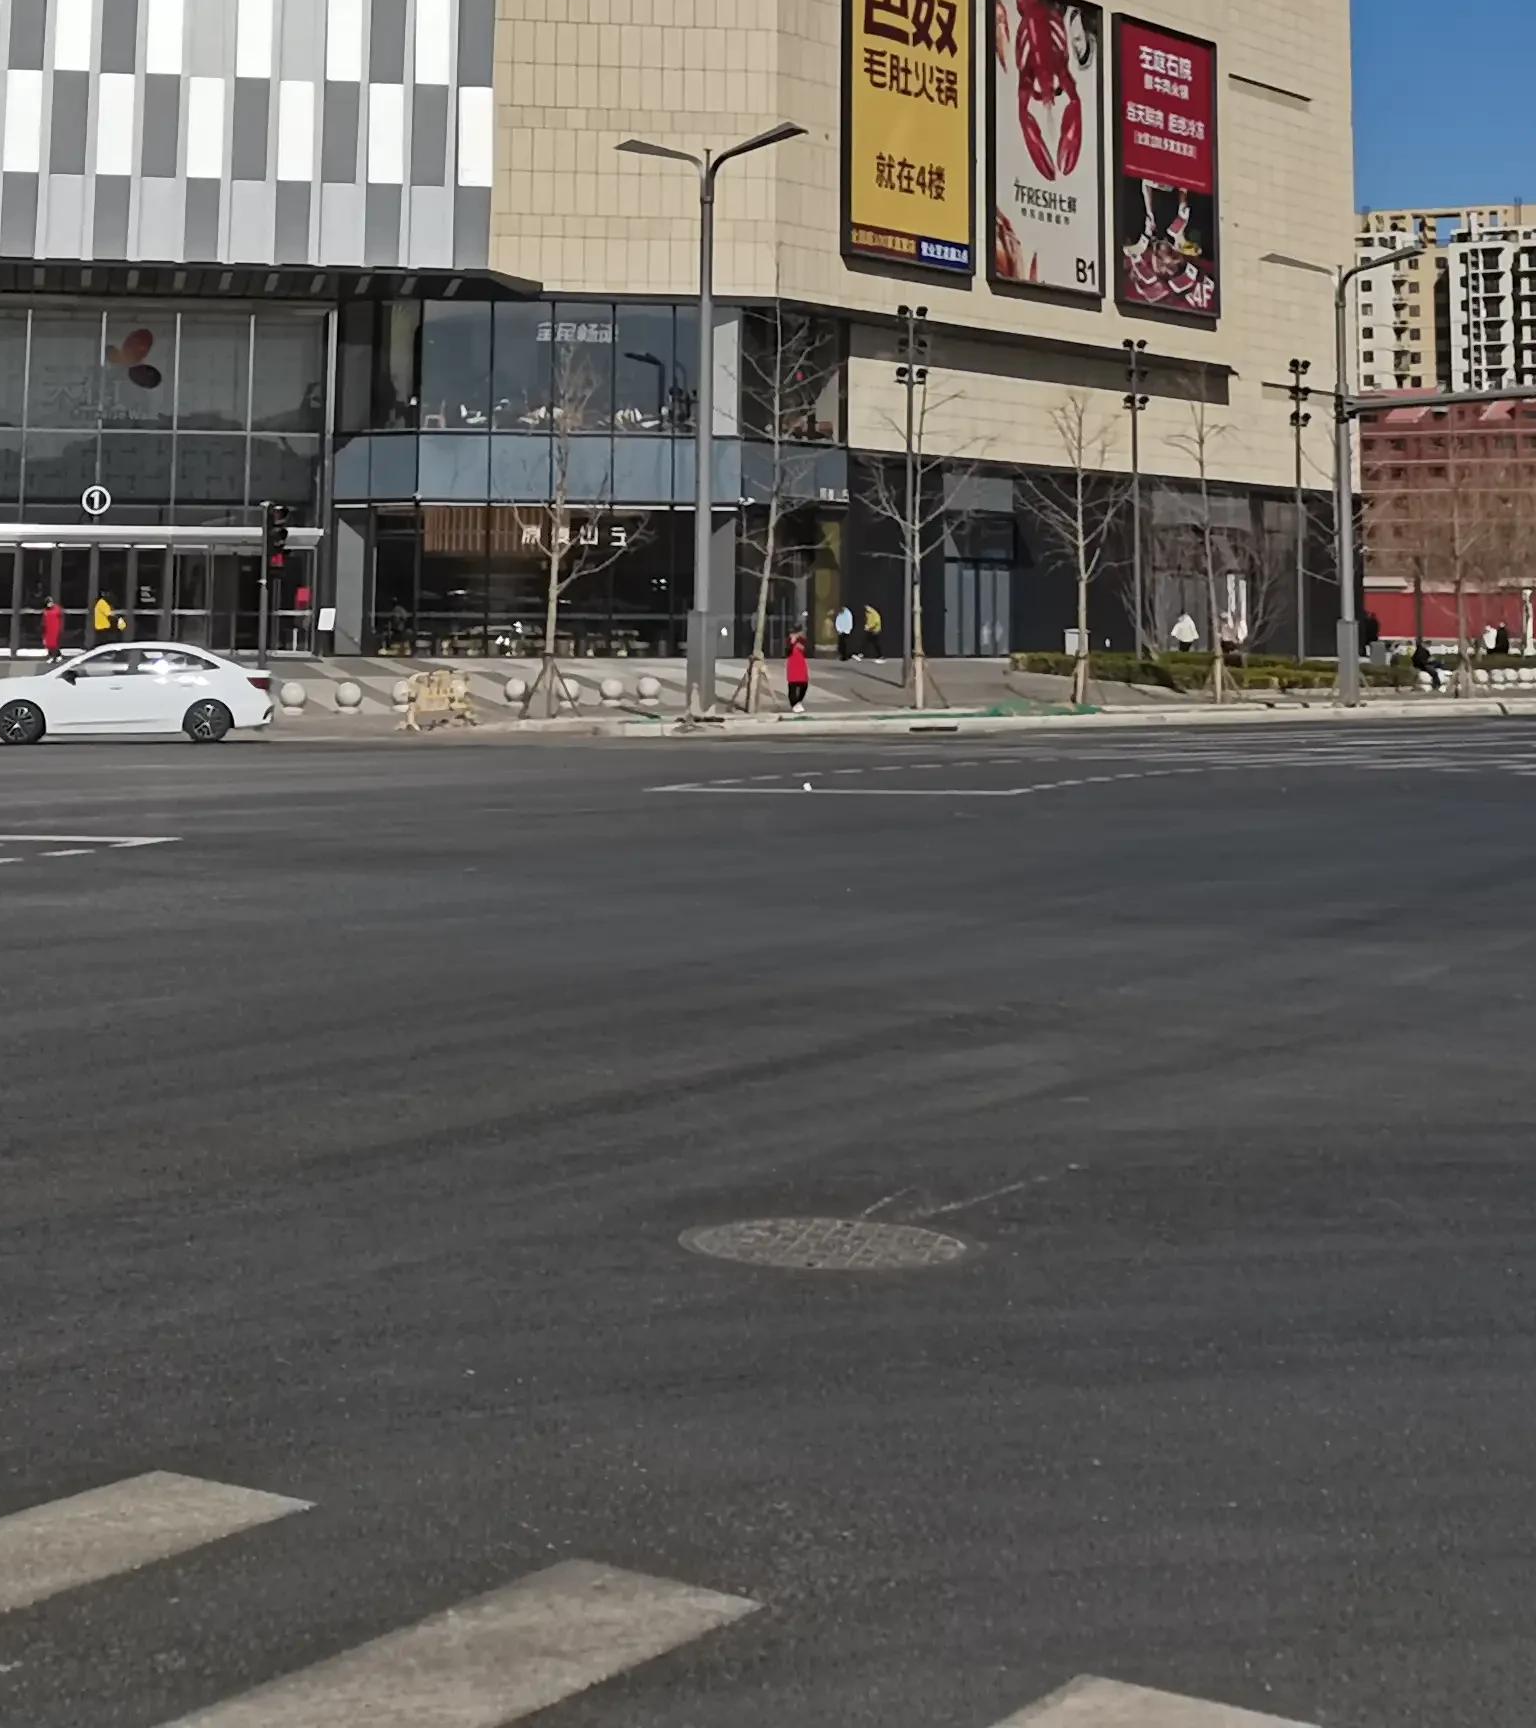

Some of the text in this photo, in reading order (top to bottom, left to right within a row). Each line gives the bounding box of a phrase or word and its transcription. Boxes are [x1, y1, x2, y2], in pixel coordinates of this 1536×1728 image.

[864, 47, 958, 109] 毛肚火锅
[875, 152, 946, 202] 就在4楼
[1076, 257, 1096, 286] B1
